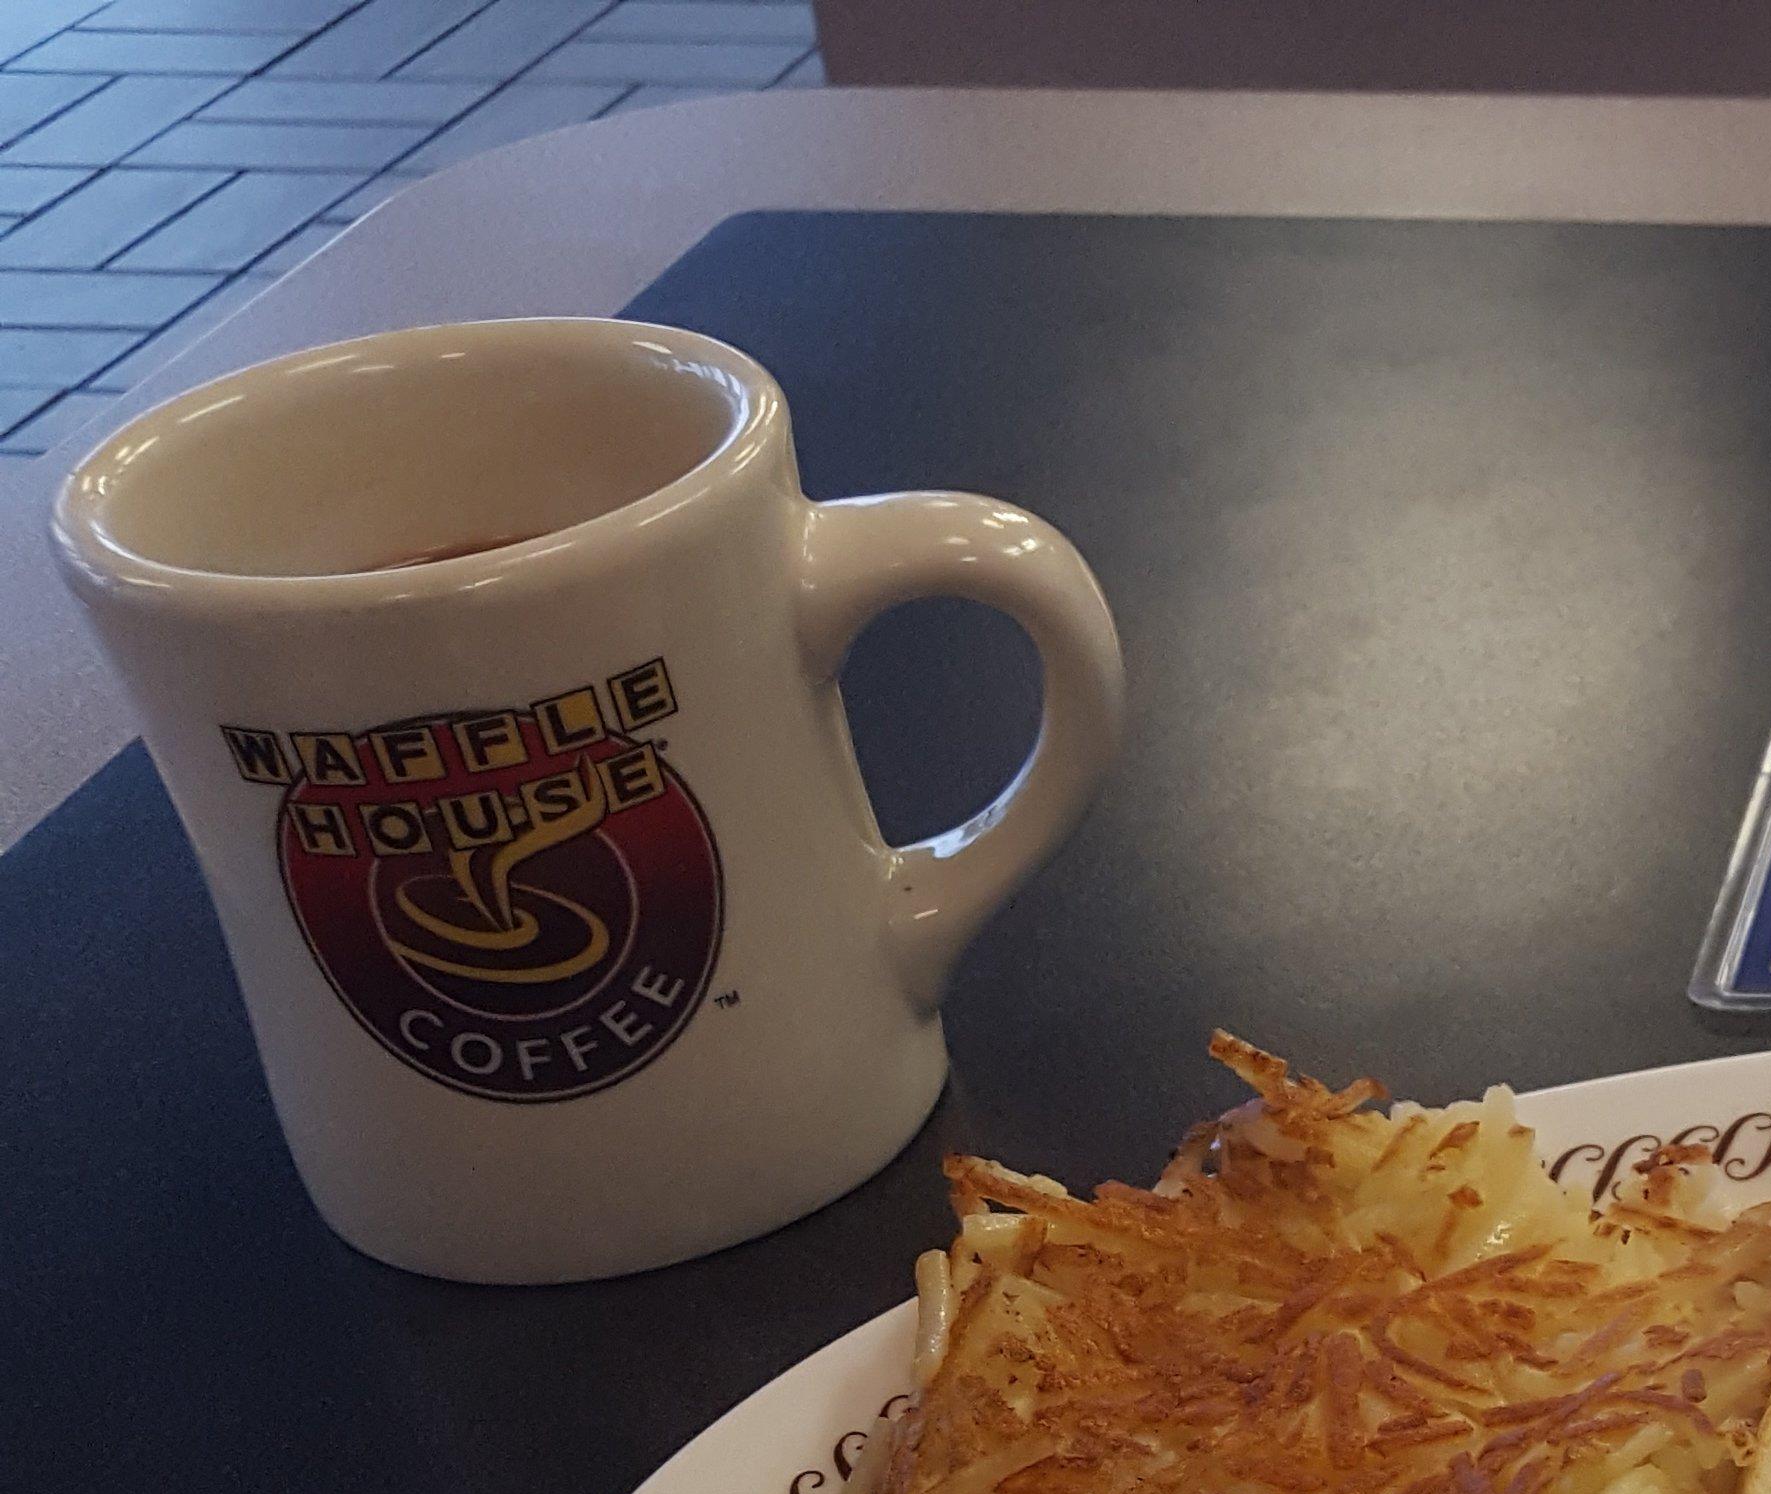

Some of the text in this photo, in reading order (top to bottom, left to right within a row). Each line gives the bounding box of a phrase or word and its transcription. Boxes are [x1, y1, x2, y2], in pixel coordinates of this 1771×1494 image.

[221, 657, 678, 786] WAFFLE
[288, 741, 665, 857] HOUSE
[399, 964, 686, 1080] COFFEE
